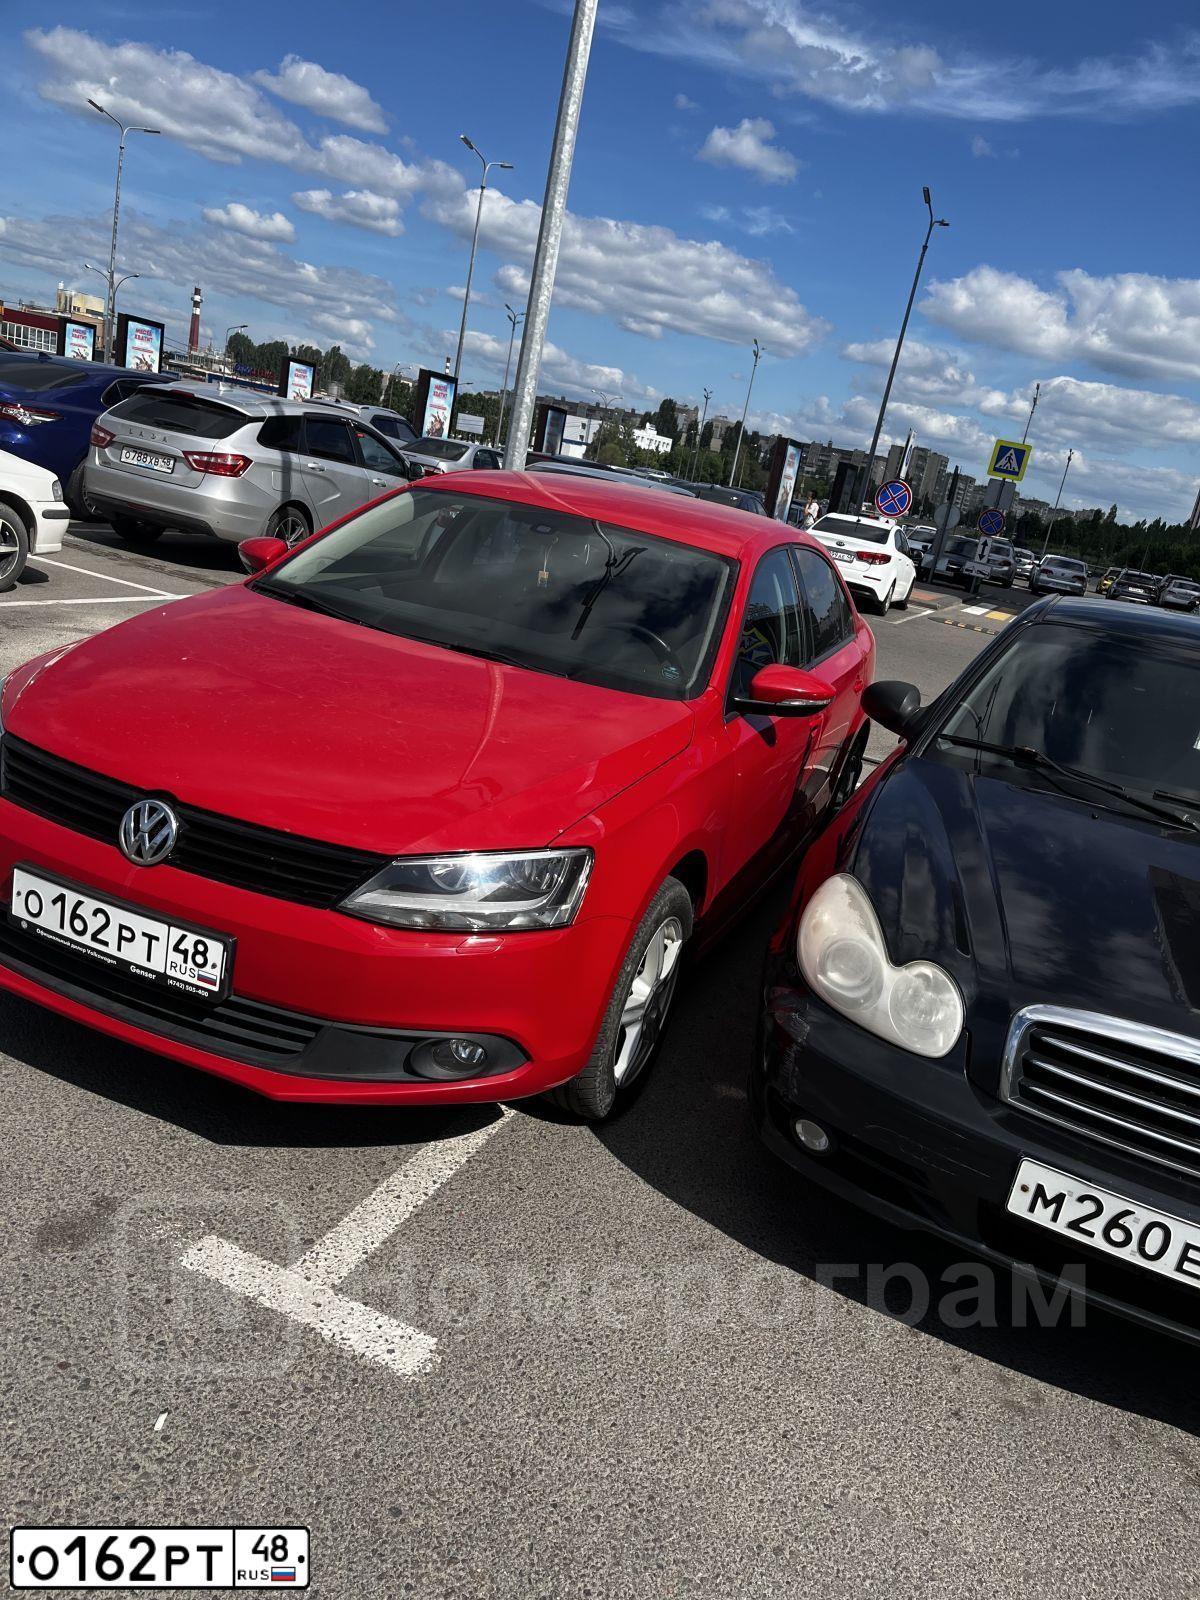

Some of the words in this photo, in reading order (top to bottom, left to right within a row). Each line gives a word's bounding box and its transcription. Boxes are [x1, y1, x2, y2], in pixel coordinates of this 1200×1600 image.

[129, 428, 168, 443] LADA
[24, 889, 160, 963] О162РТ
[172, 933, 209, 969] 48
[36, 928, 71, 947] Официальный
[87, 948, 117, 965] Volkswagen
[130, 965, 156, 980] Genser
[169, 960, 196, 979] RUS
